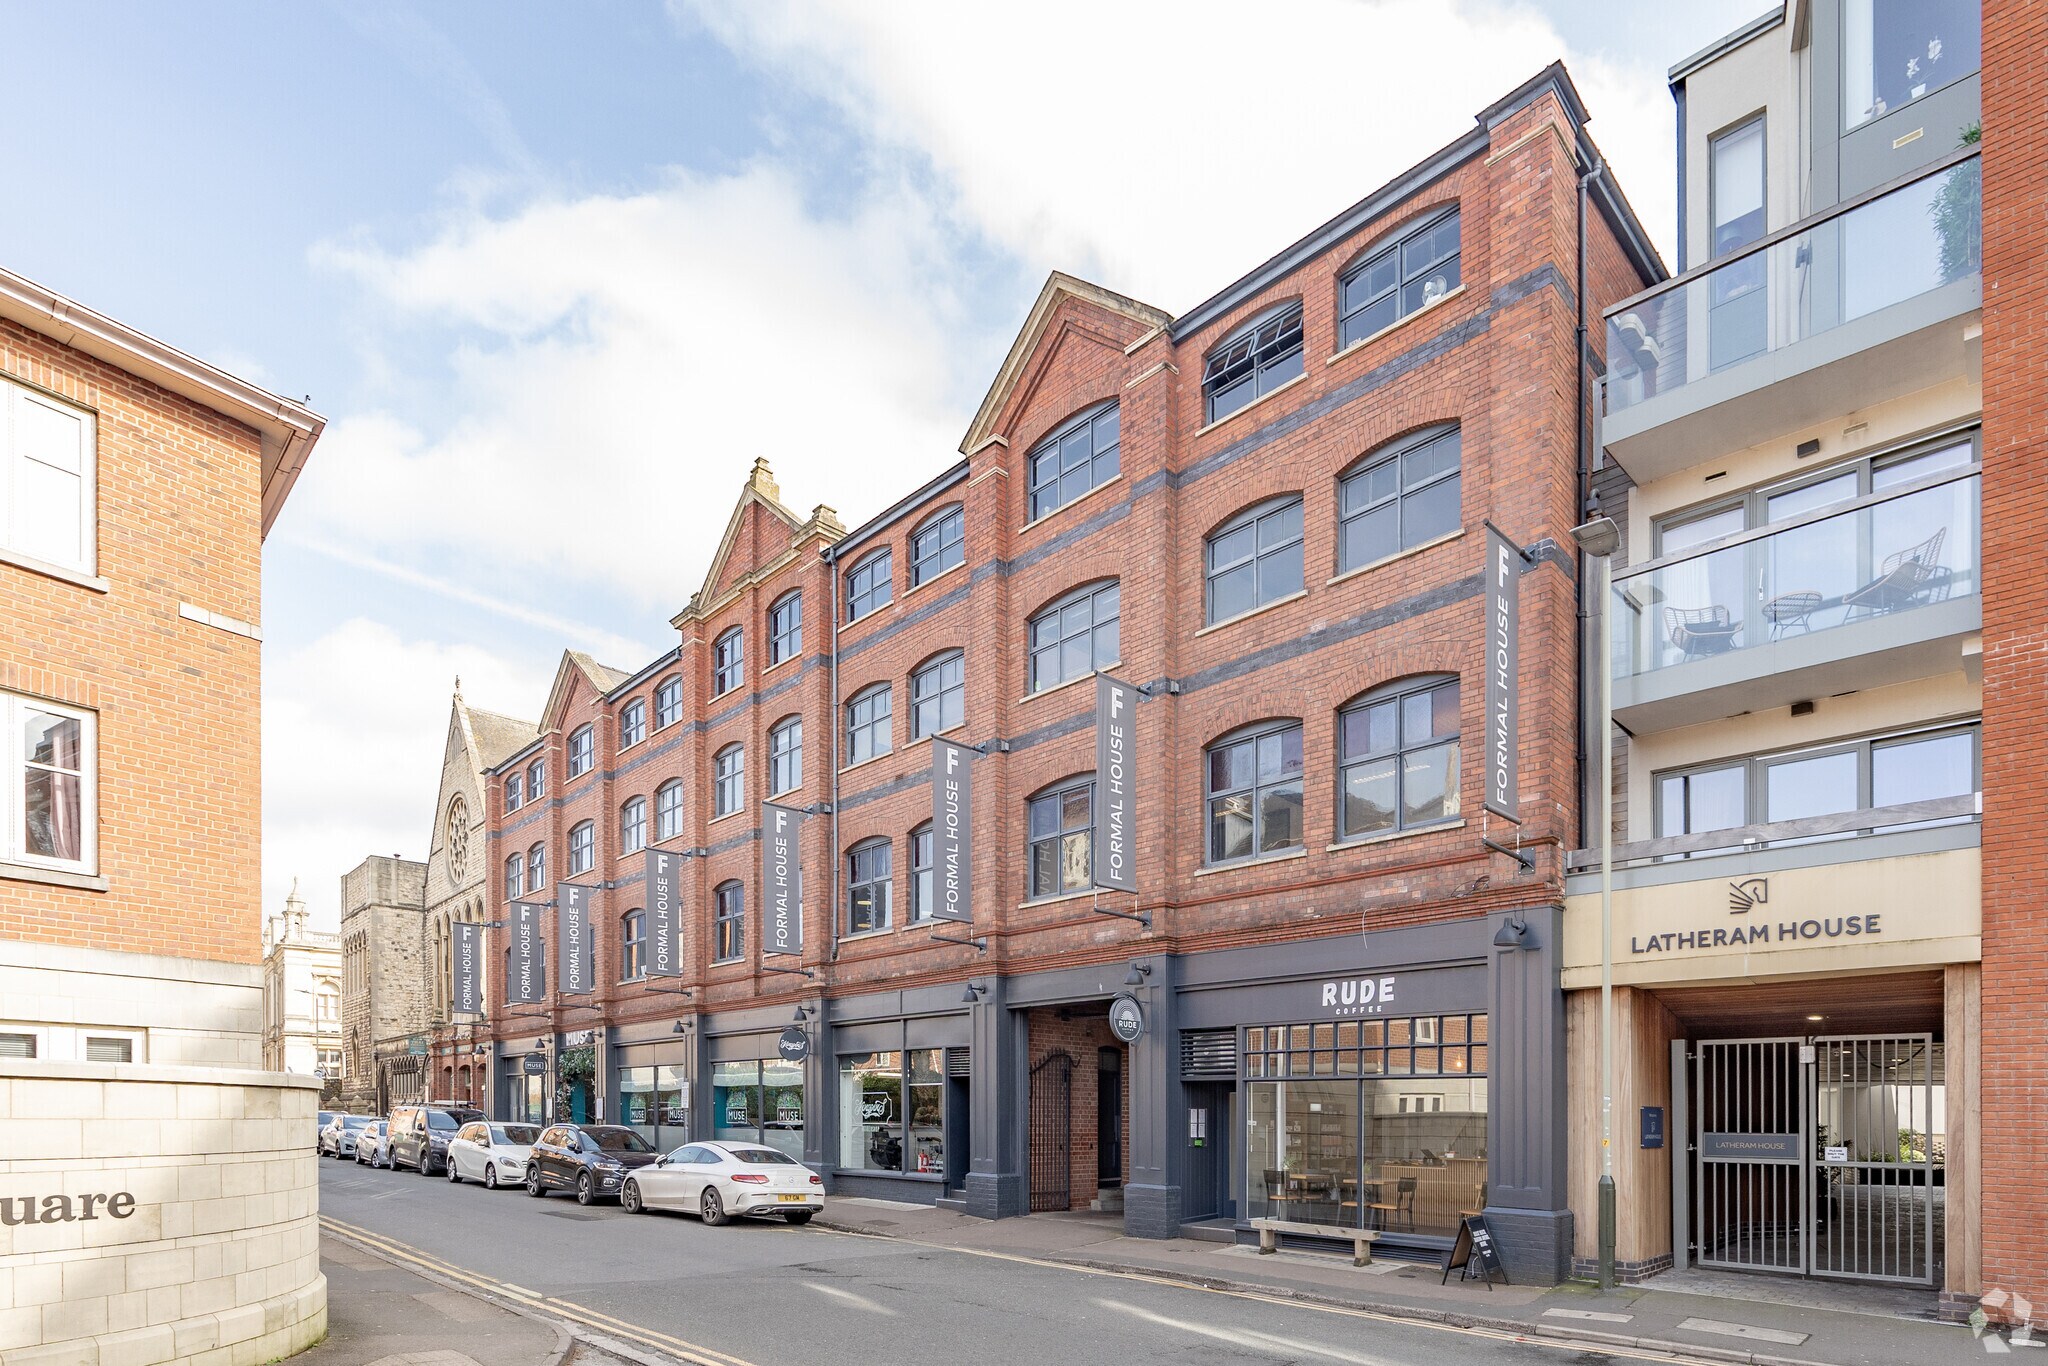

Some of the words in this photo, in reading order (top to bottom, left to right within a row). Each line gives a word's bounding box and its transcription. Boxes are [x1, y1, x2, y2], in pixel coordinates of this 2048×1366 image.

[1497, 595, 1508, 691] HOUSE
[1110, 724, 1124, 795] HOUSE
[1496, 697, 1508, 806] FORMAL
[946, 780, 959, 840] HOUSE
[1110, 799, 1124, 881] FORMAL
[775, 837, 788, 887] HOUSE
[946, 843, 959, 914] FORMAL
[657, 877, 668, 919] HOUSE
[569, 907, 579, 945] HOUSE
[776, 889, 789, 948] FORMAL
[1631, 925, 1769, 954] LATHERAM
[1778, 914, 1881, 942] HOUSE
[462, 942, 472, 975] HOUSE
[520, 923, 530, 958] HOUSE
[657, 920, 668, 971] FORMAL
[521, 958, 531, 999] FORMAL
[569, 946, 580, 990] FORMAL
[463, 976, 472, 1010] FORMAL
[1321, 977, 1396, 1008] RUDE
[1335, 1005, 1383, 1016] COFFEE
[1118, 1020, 1137, 1029] RUDE
[631, 1109, 645, 1119] MUSE
[669, 1109, 683, 1119] MUSE
[728, 1110, 746, 1121] MUSE
[779, 1110, 799, 1121] MUSE
[1715, 1141, 1757, 1149] LATHERAM
[1758, 1142, 1786, 1150] HOUSE
